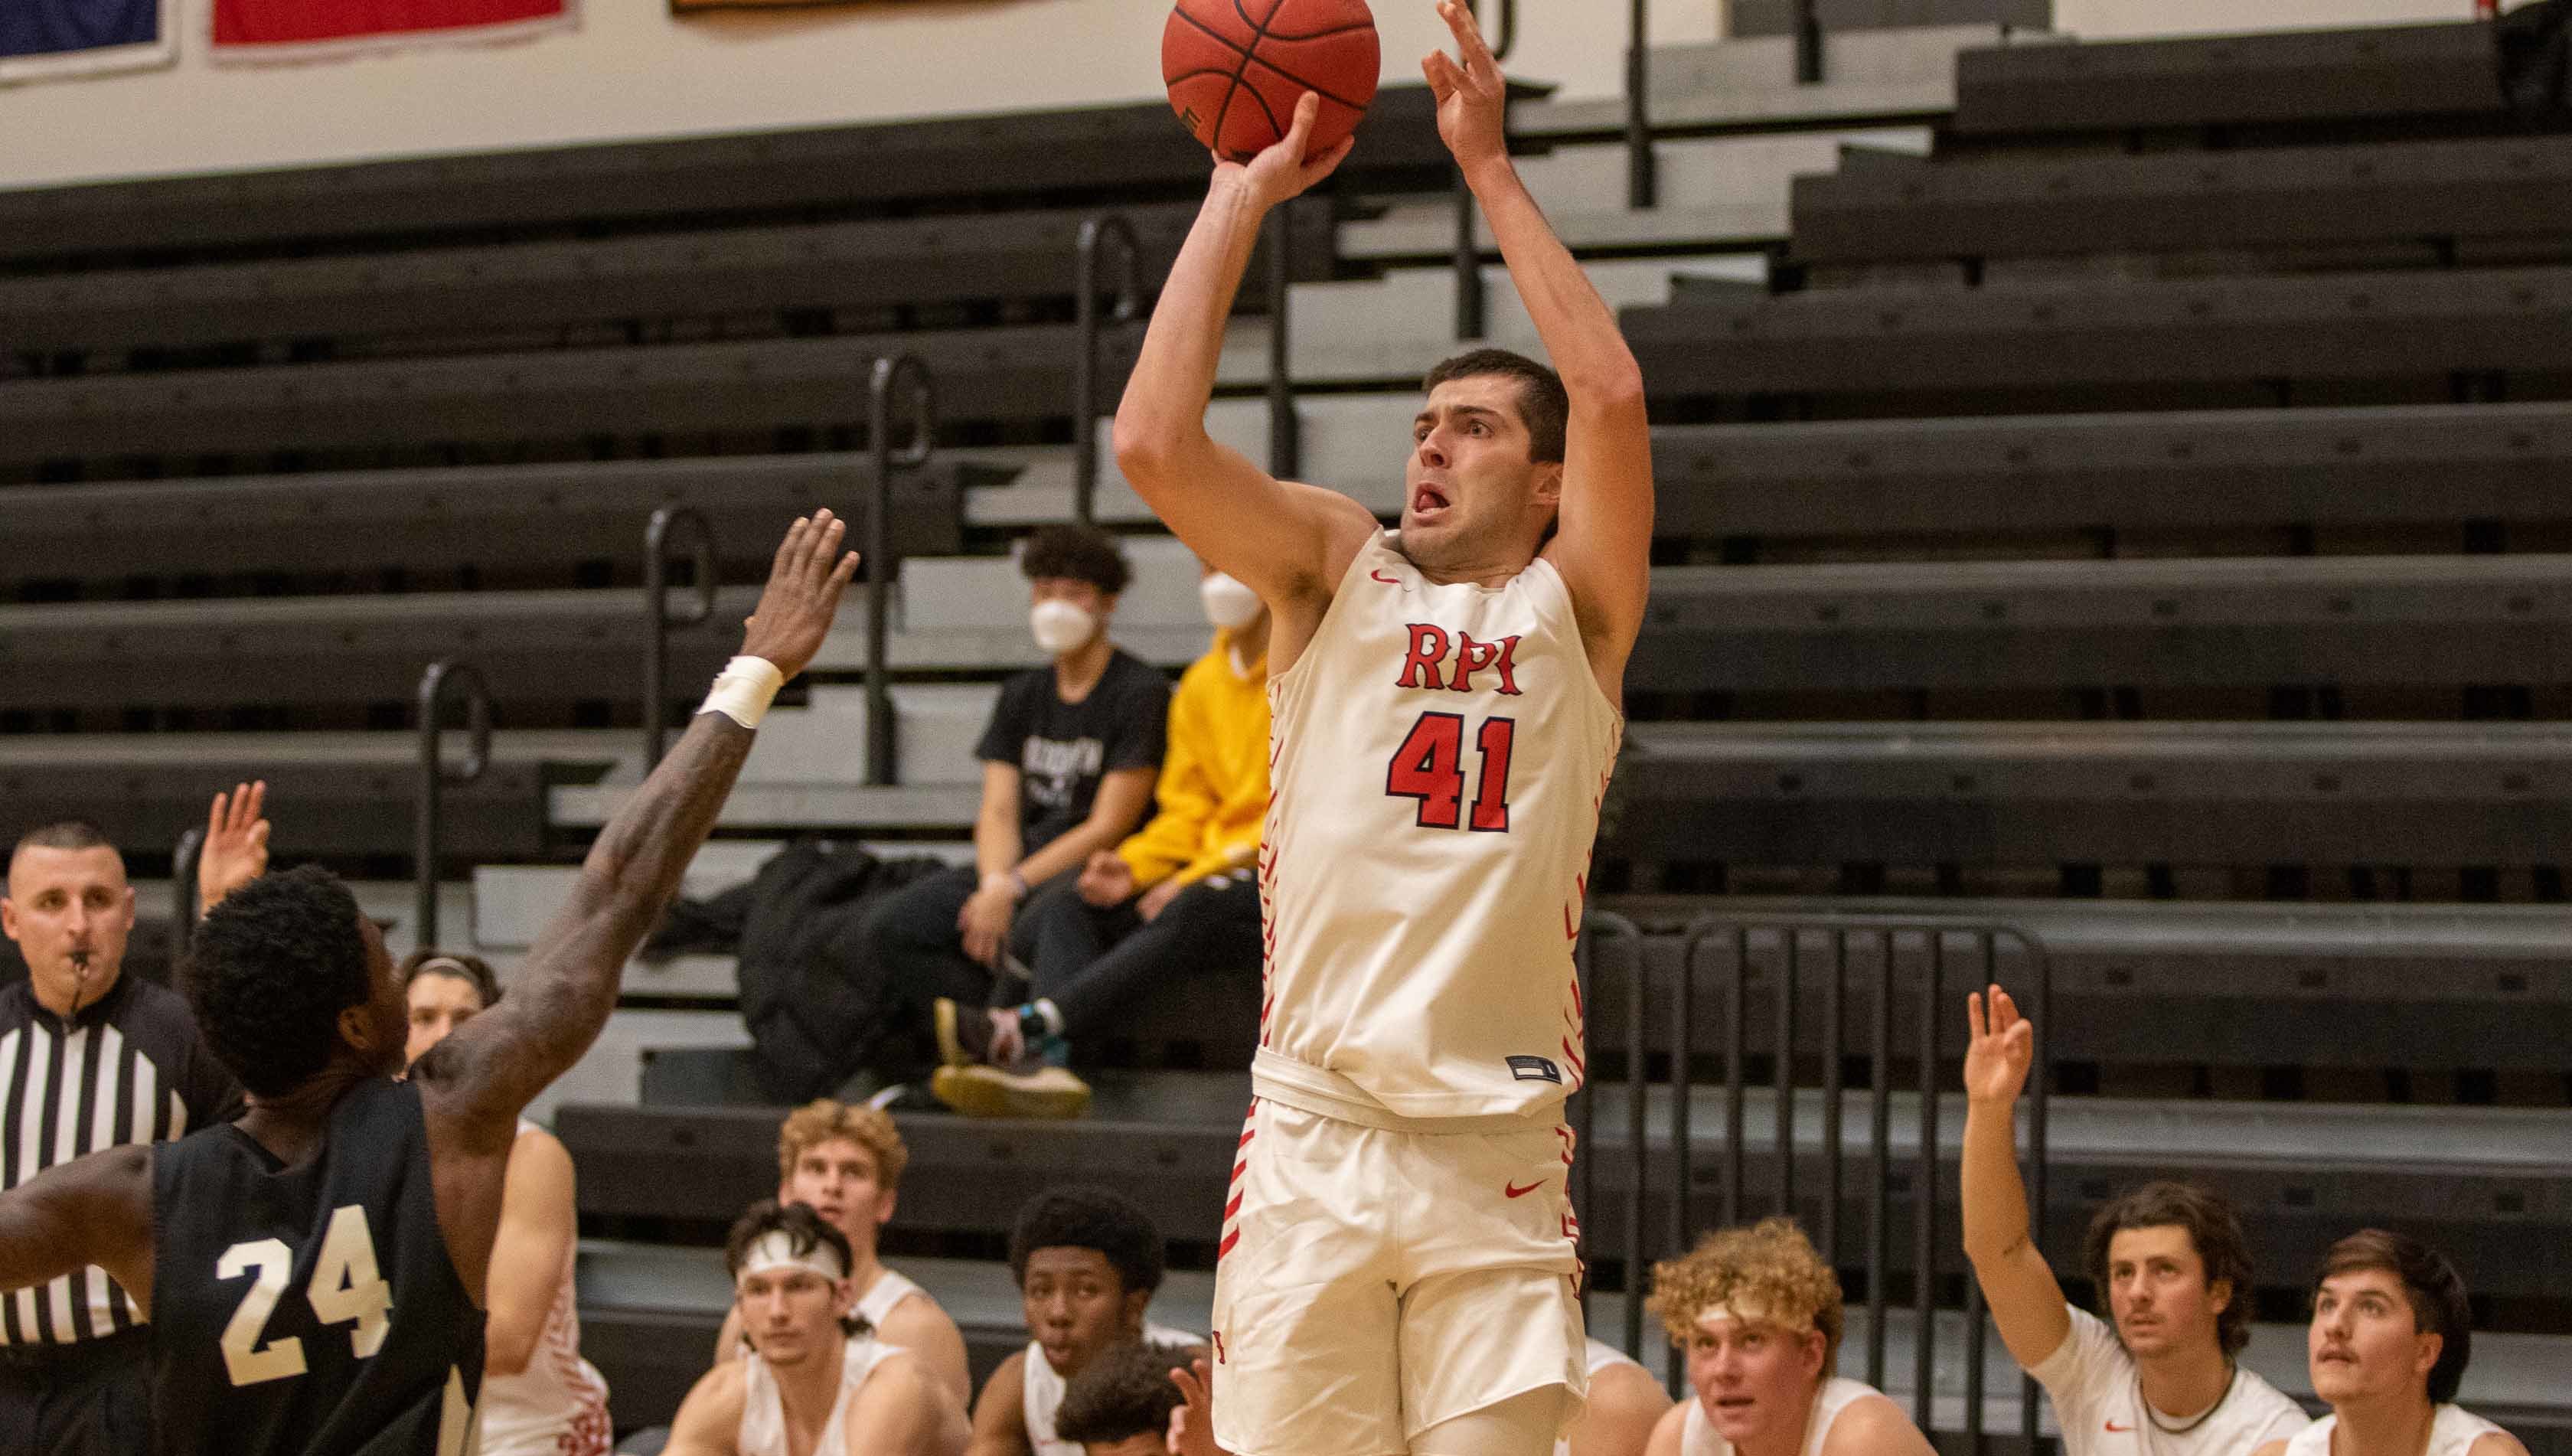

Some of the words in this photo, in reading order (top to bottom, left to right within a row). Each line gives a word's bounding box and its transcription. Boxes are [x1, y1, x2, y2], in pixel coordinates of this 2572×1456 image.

[1395, 623, 1523, 695] RPI
[1386, 710, 1515, 833] 41
[216, 1203, 394, 1386] 24
